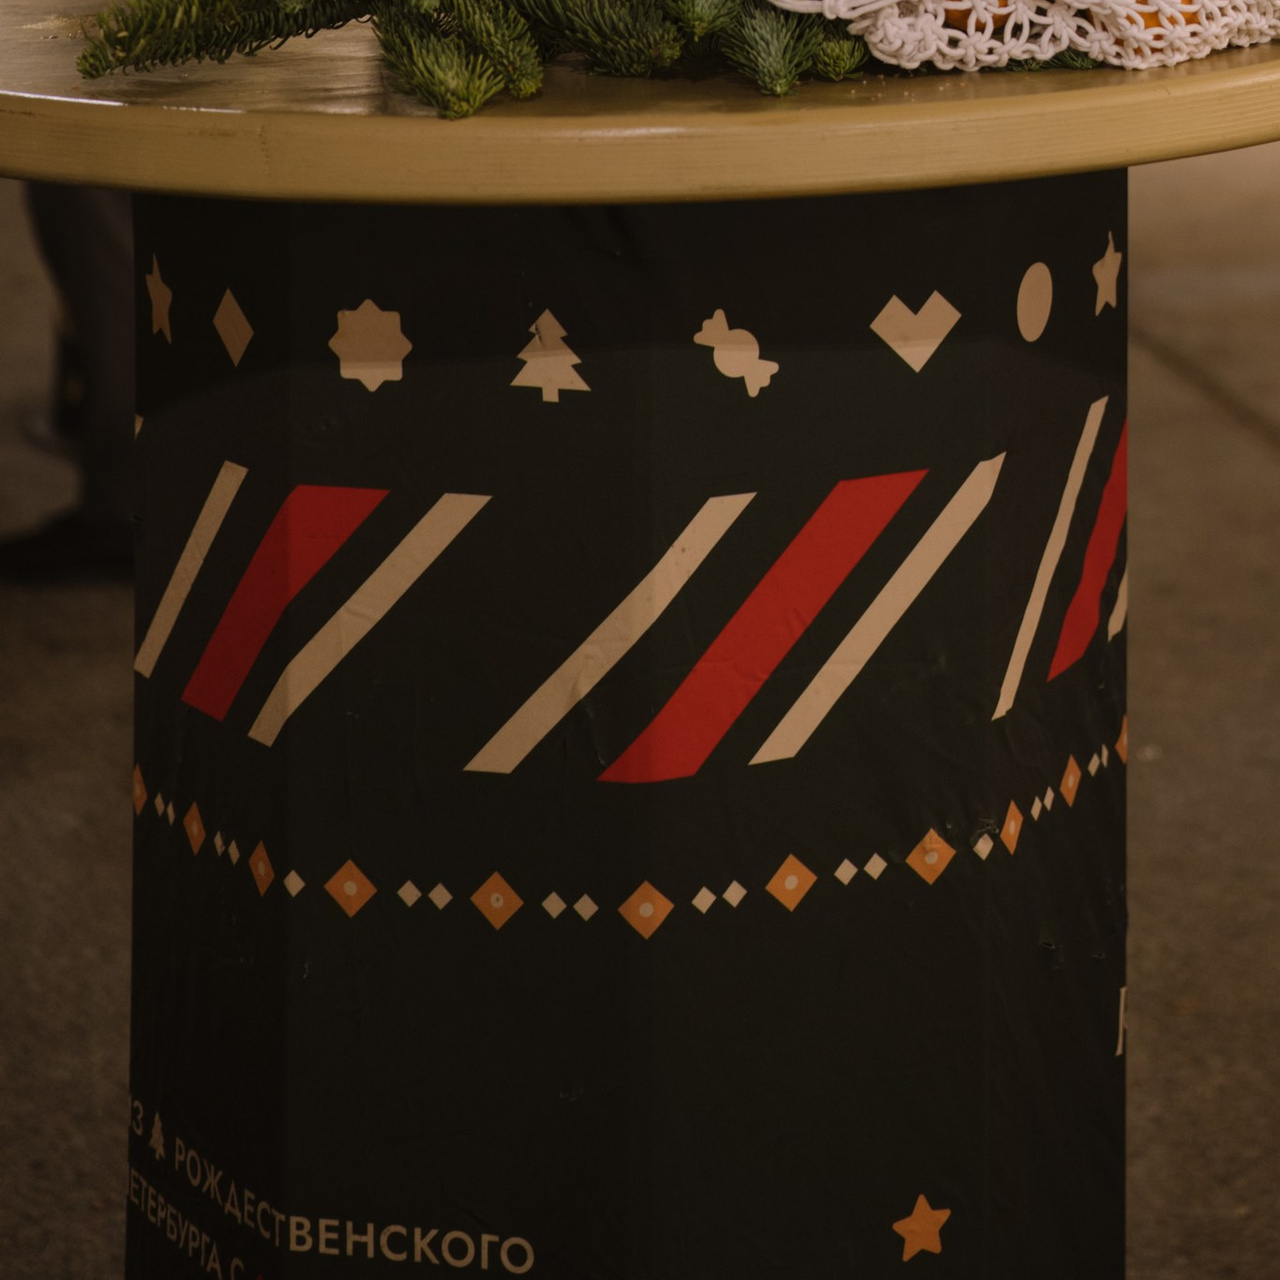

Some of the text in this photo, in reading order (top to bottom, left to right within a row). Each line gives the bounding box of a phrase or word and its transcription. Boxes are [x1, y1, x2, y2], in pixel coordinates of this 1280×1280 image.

[128, 1164, 223, 1280] ЕТЕРБУРГА
[129, 1095, 535, 1274] З РОЖДЕСТВЕНСКОГО
